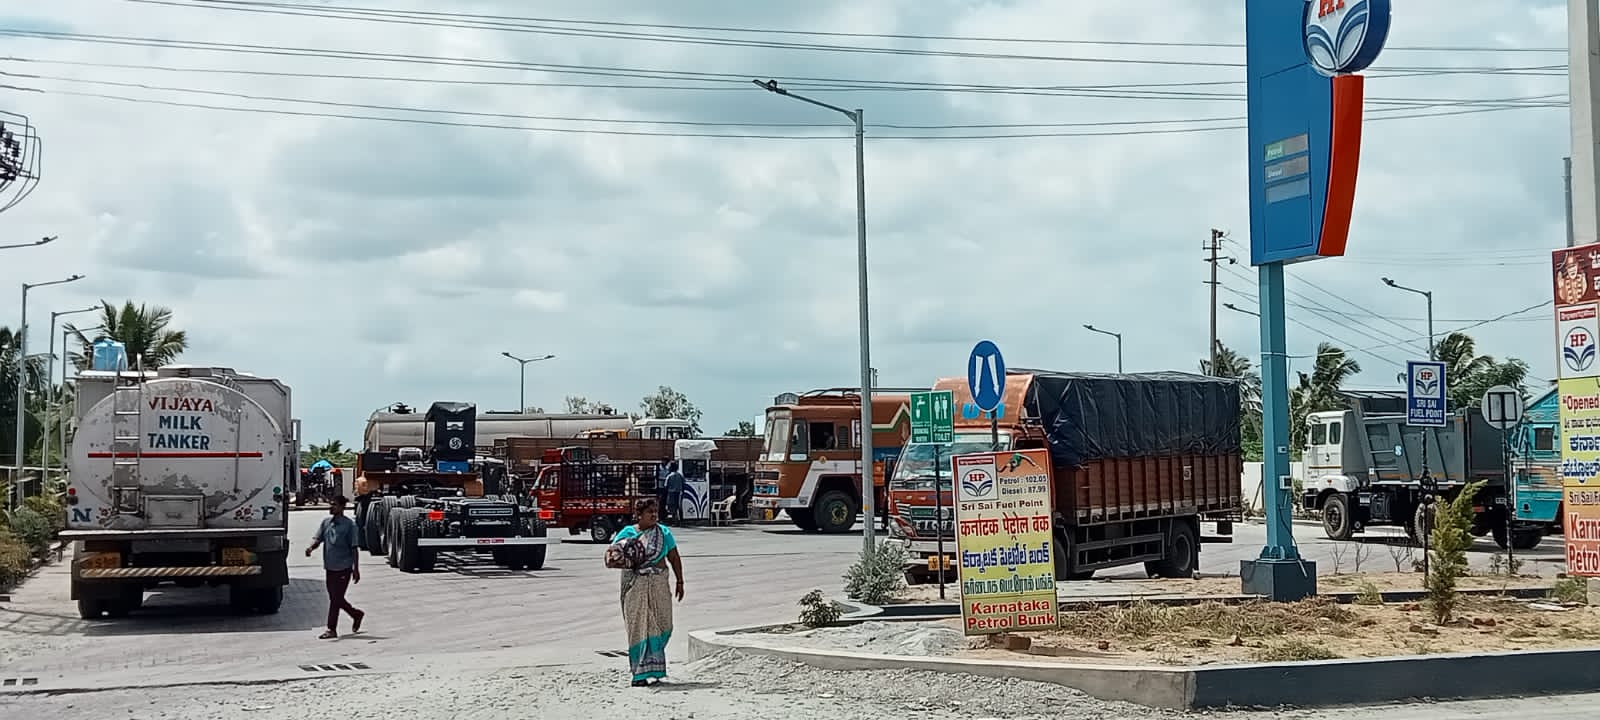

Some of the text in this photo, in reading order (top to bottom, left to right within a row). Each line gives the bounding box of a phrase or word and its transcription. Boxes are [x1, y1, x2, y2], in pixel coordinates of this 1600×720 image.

[1570, 334, 1587, 348] HP
[1421, 372, 1432, 380] HP
[148, 397, 214, 412] VIJAYA
[1427, 400, 1437, 409] SAI
[1410, 408, 1443, 418] FUEL POINT
[158, 415, 202, 430] MILK
[147, 432, 210, 450] TANKER
[968, 473, 985, 482] HP
[999, 477, 1020, 485] Petrol
[1001, 487, 1023, 495] Diesel
[961, 499, 1043, 511] Sri Sai Fuel Point
[71, 506, 276, 522] N P
[970, 600, 1050, 615] Karnataka
[967, 613, 1055, 630] Petrol Bunk
